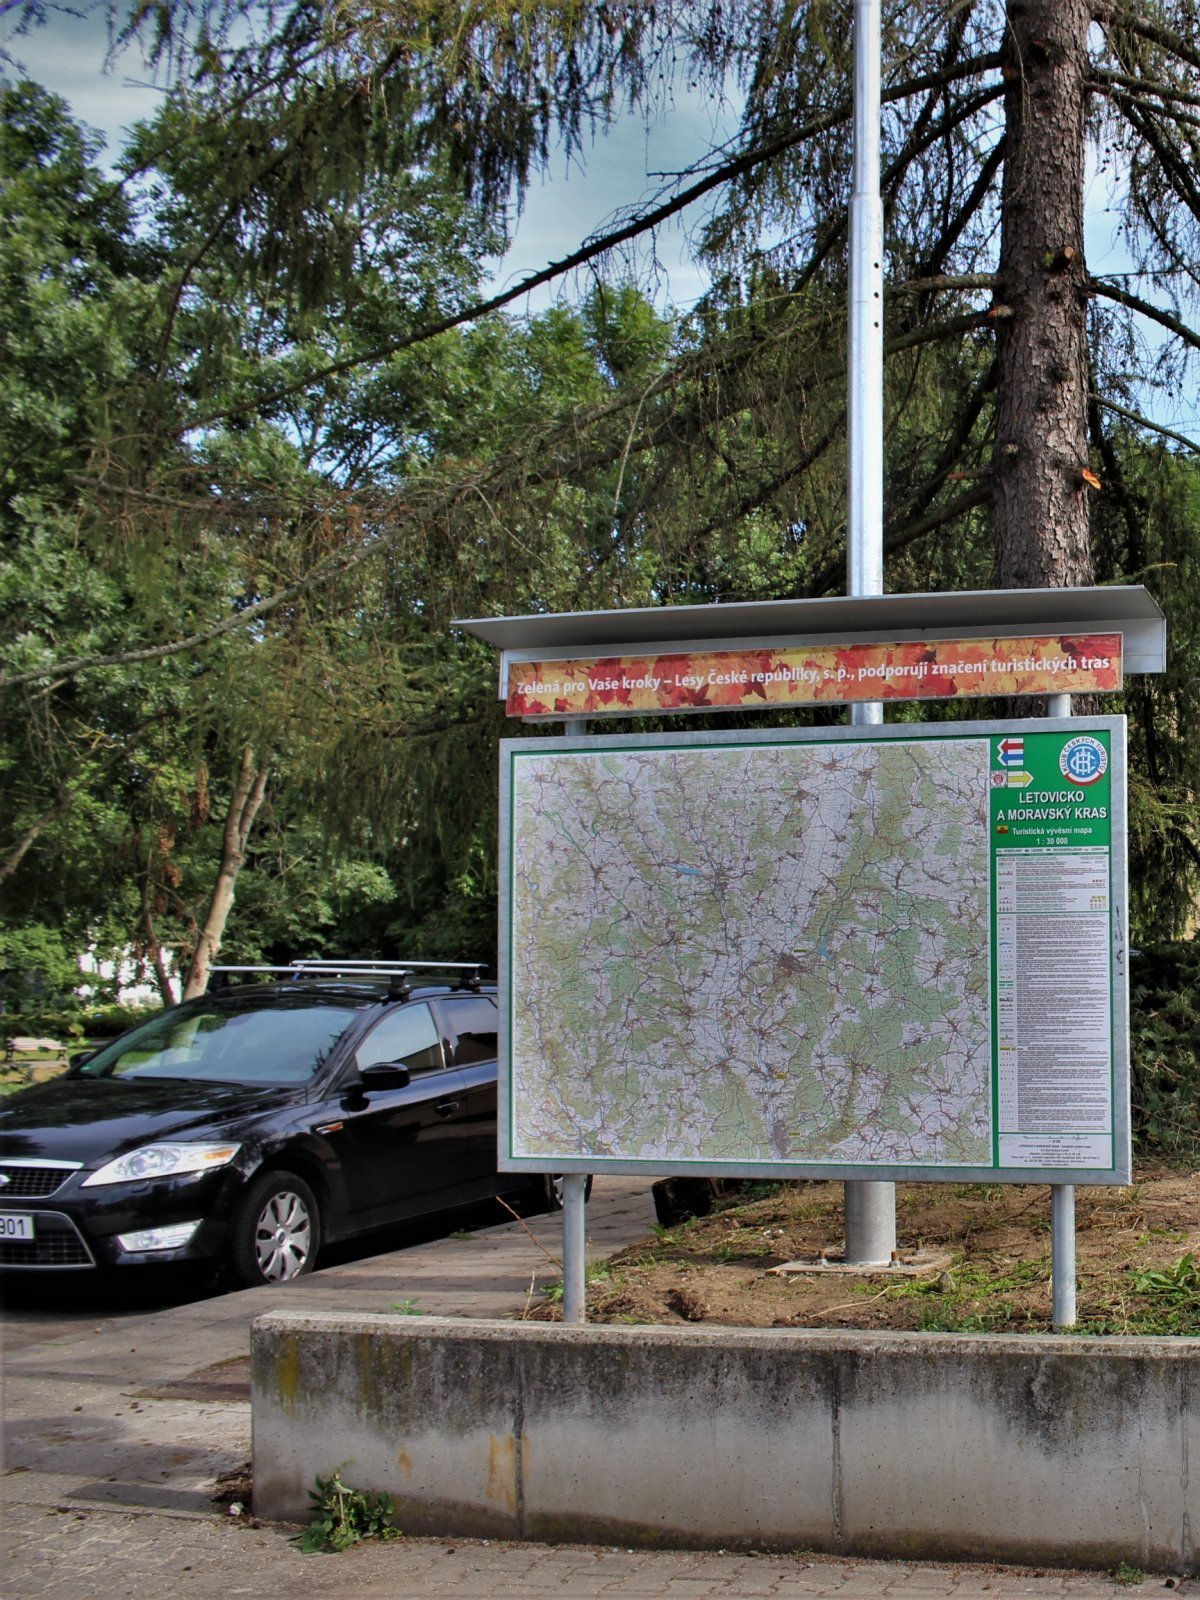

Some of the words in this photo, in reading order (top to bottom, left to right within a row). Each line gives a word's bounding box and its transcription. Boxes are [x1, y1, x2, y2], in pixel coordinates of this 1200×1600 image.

[517, 680, 560, 695] Zelená
[563, 682, 585, 697] pro
[588, 676, 619, 692] Vaše
[622, 675, 661, 693] kroky
[675, 672, 704, 690] Lesy
[708, 668, 748, 686] České
[751, 666, 820, 684] republiky,
[823, 669, 835, 680] s.
[838, 668, 855, 682] p.,
[858, 660, 929, 682] podporují
[932, 659, 988, 675] značení
[991, 656, 1078, 674] turistických
[1080, 656, 1110, 670] tras
[1019, 790, 1085, 804] LETOVICKO
[997, 810, 1006, 820] A
[1008, 806, 1072, 820] MORAVSKÝ
[1075, 807, 1108, 819] KRAS
[1012, 827, 1044, 835] Turistická
[1046, 826, 1072, 836] vývěsní
[1074, 828, 1092, 836] mapa
[0, 1218, 24, 1236] 901
